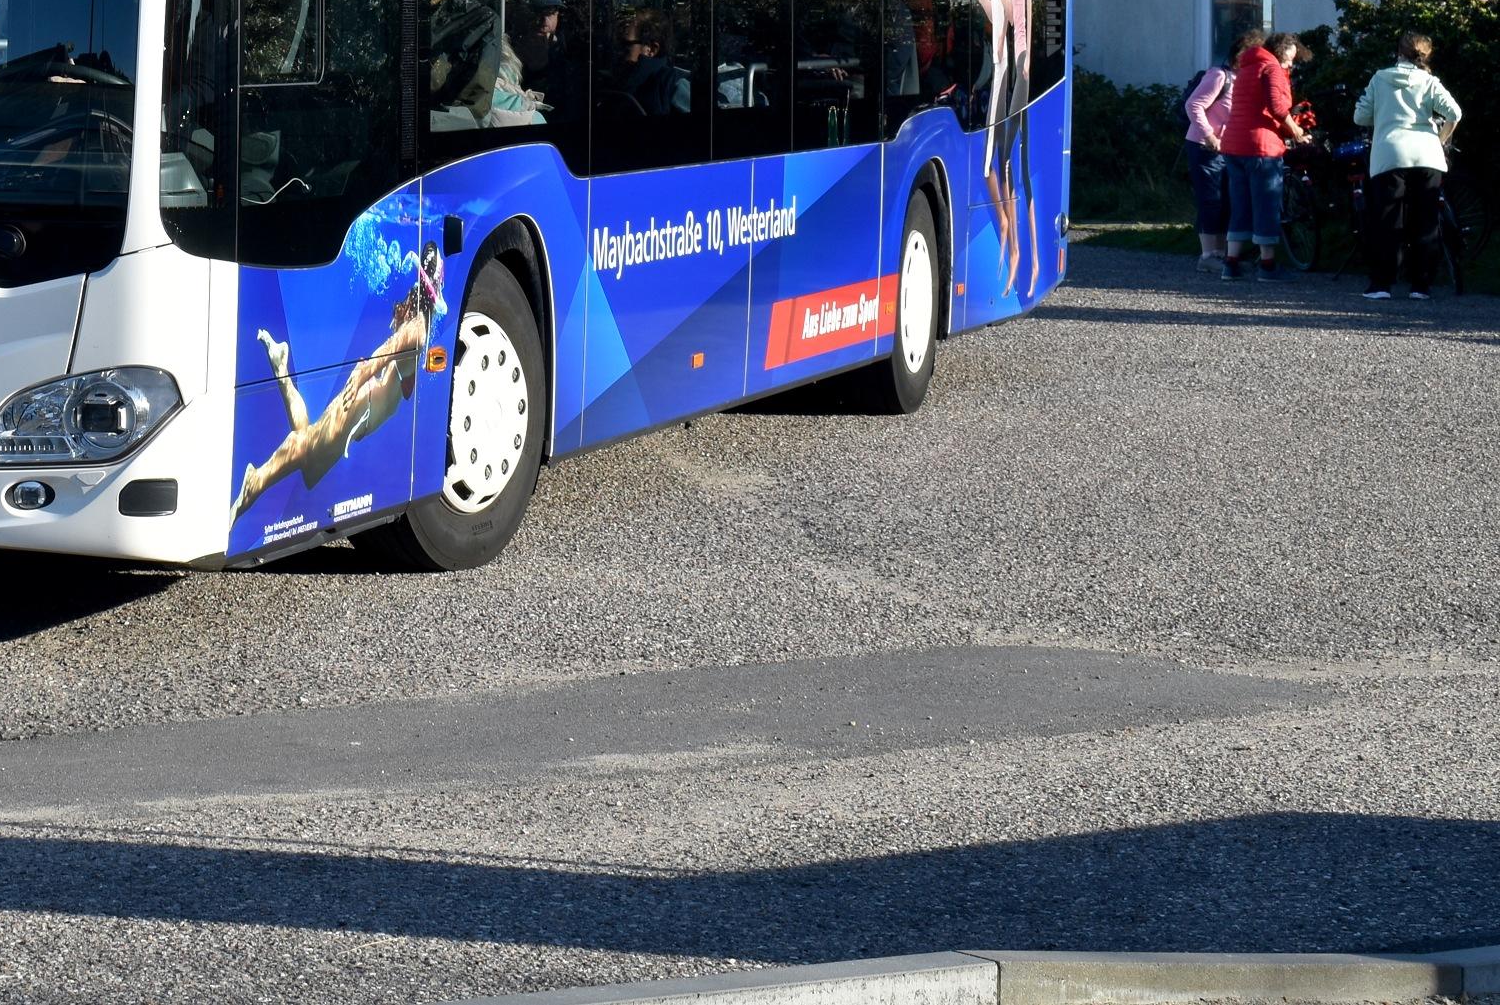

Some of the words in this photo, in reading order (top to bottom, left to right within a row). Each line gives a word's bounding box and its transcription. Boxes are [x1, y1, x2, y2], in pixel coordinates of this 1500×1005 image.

[593, 210, 702, 280] Maybachstraße
[706, 209, 724, 256] 10,
[727, 195, 796, 247] Westerland
[802, 308, 819, 340] Aus
[819, 301, 842, 335] Liebe
[841, 303, 858, 329] zum
[858, 293, 879, 332] Sport
